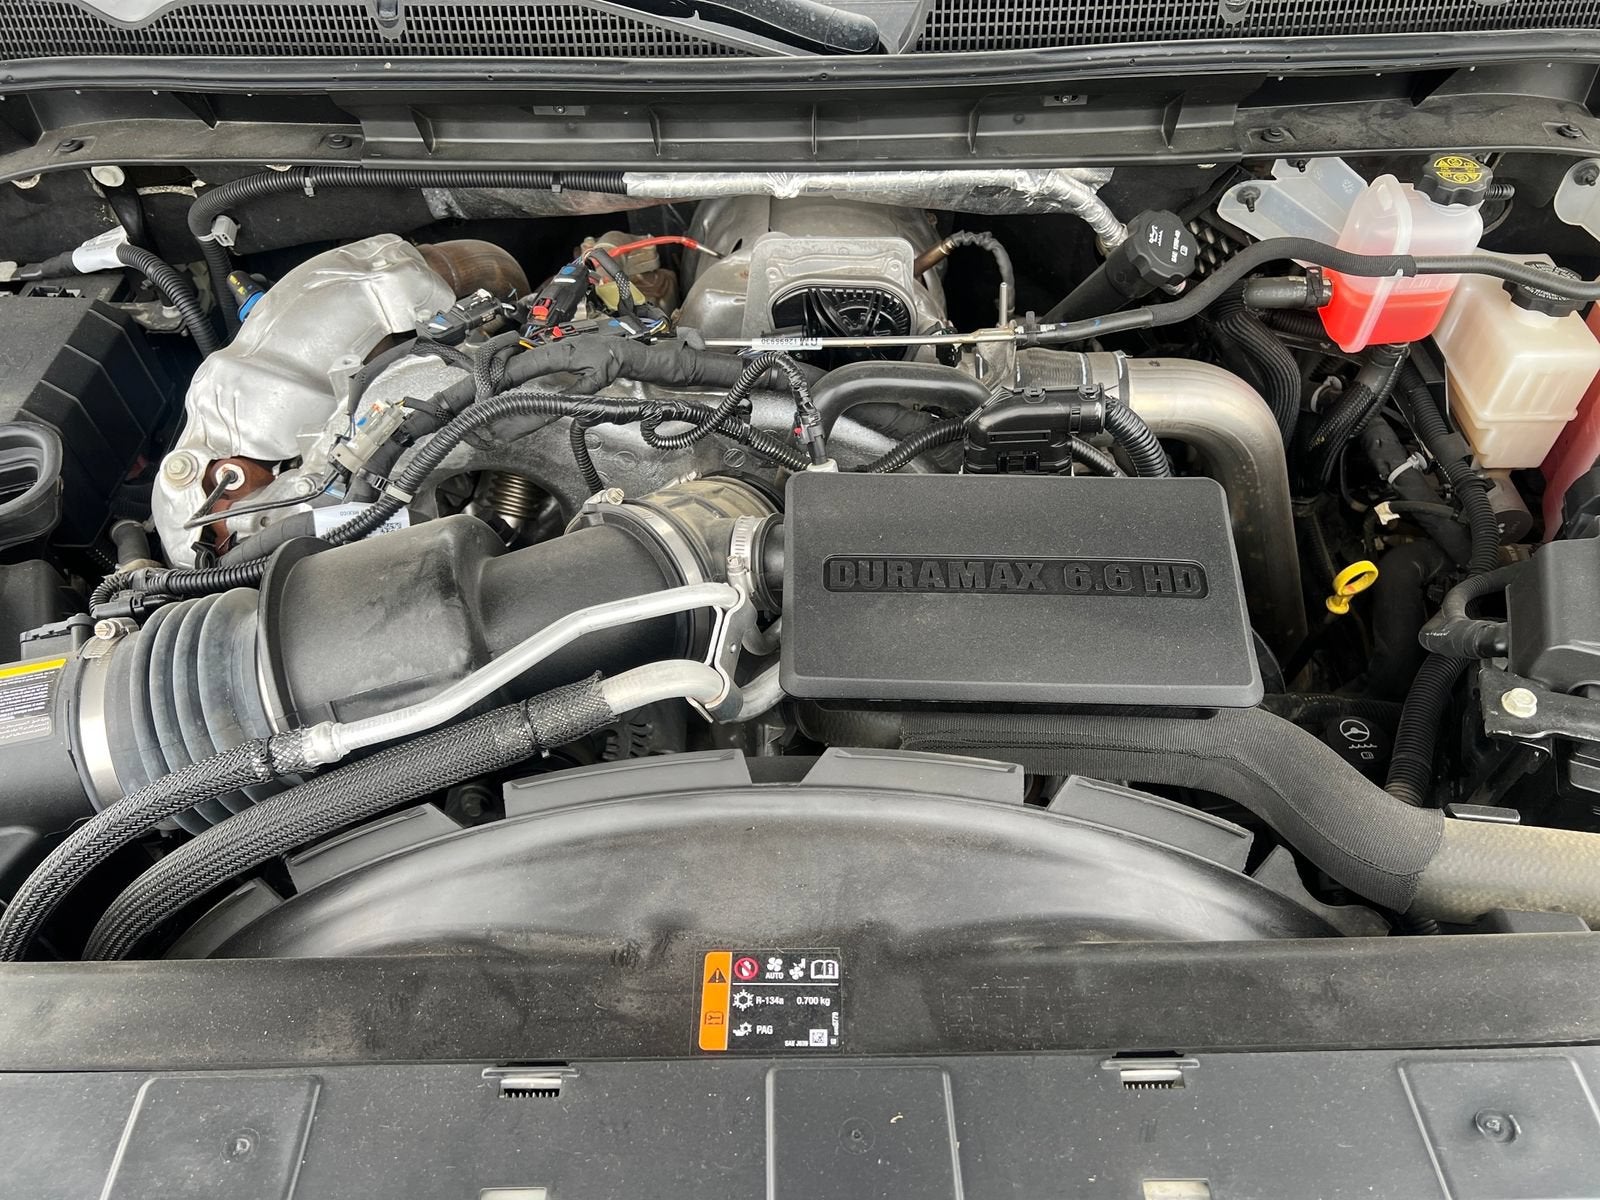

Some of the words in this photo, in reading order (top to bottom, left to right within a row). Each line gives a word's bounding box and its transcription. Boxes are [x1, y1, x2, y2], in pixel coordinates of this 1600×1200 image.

[828, 560, 1046, 591] DURAMAX
[1064, 562, 1134, 592] 6.6
[1141, 564, 1202, 595] HD
[765, 972, 784, 980] AUTO
[755, 994, 785, 1005] R-134a
[796, 995, 819, 1005] 0.700
[820, 995, 831, 1007] kg
[756, 1025, 774, 1035] PAG
